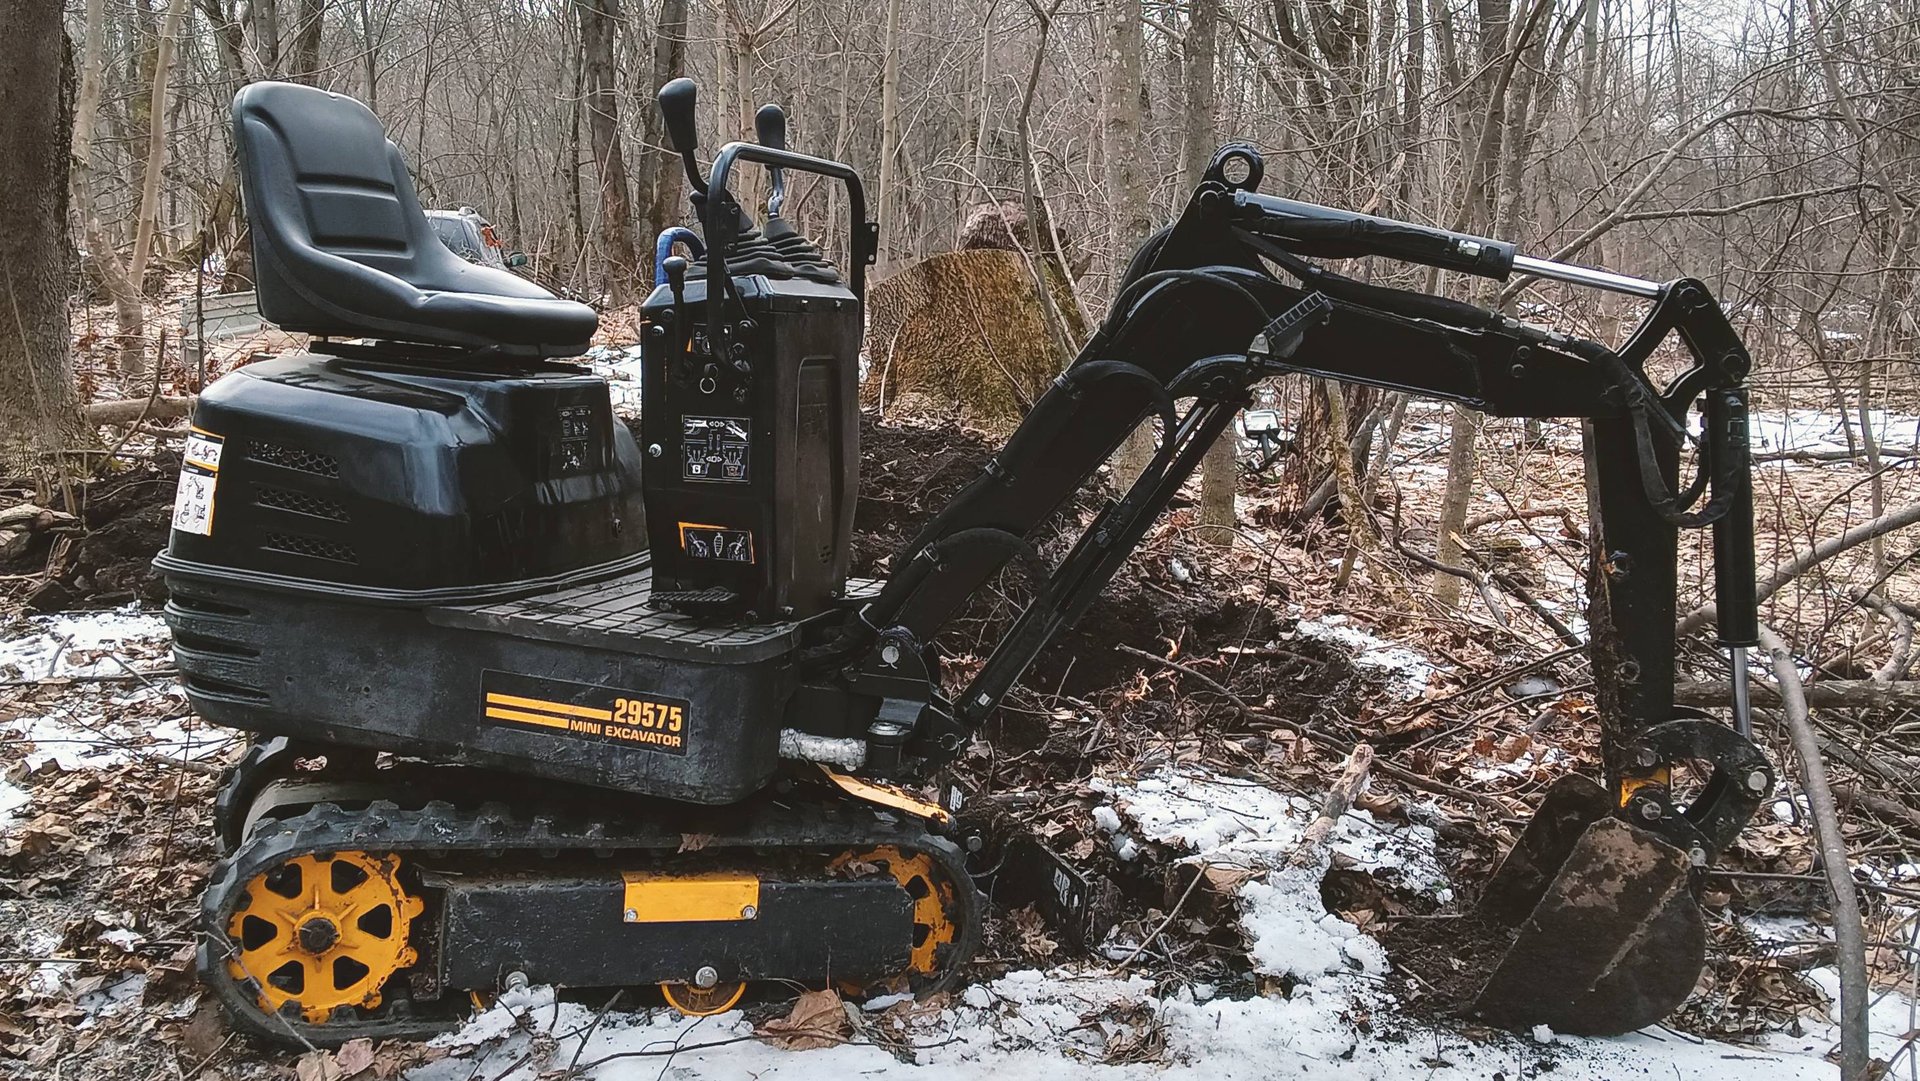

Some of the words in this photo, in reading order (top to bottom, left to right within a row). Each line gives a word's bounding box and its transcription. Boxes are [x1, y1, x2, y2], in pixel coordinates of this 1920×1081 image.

[614, 698, 682, 732] 29575
[570, 719, 601, 735] MINI
[605, 725, 681, 747] EXCAVATOR
